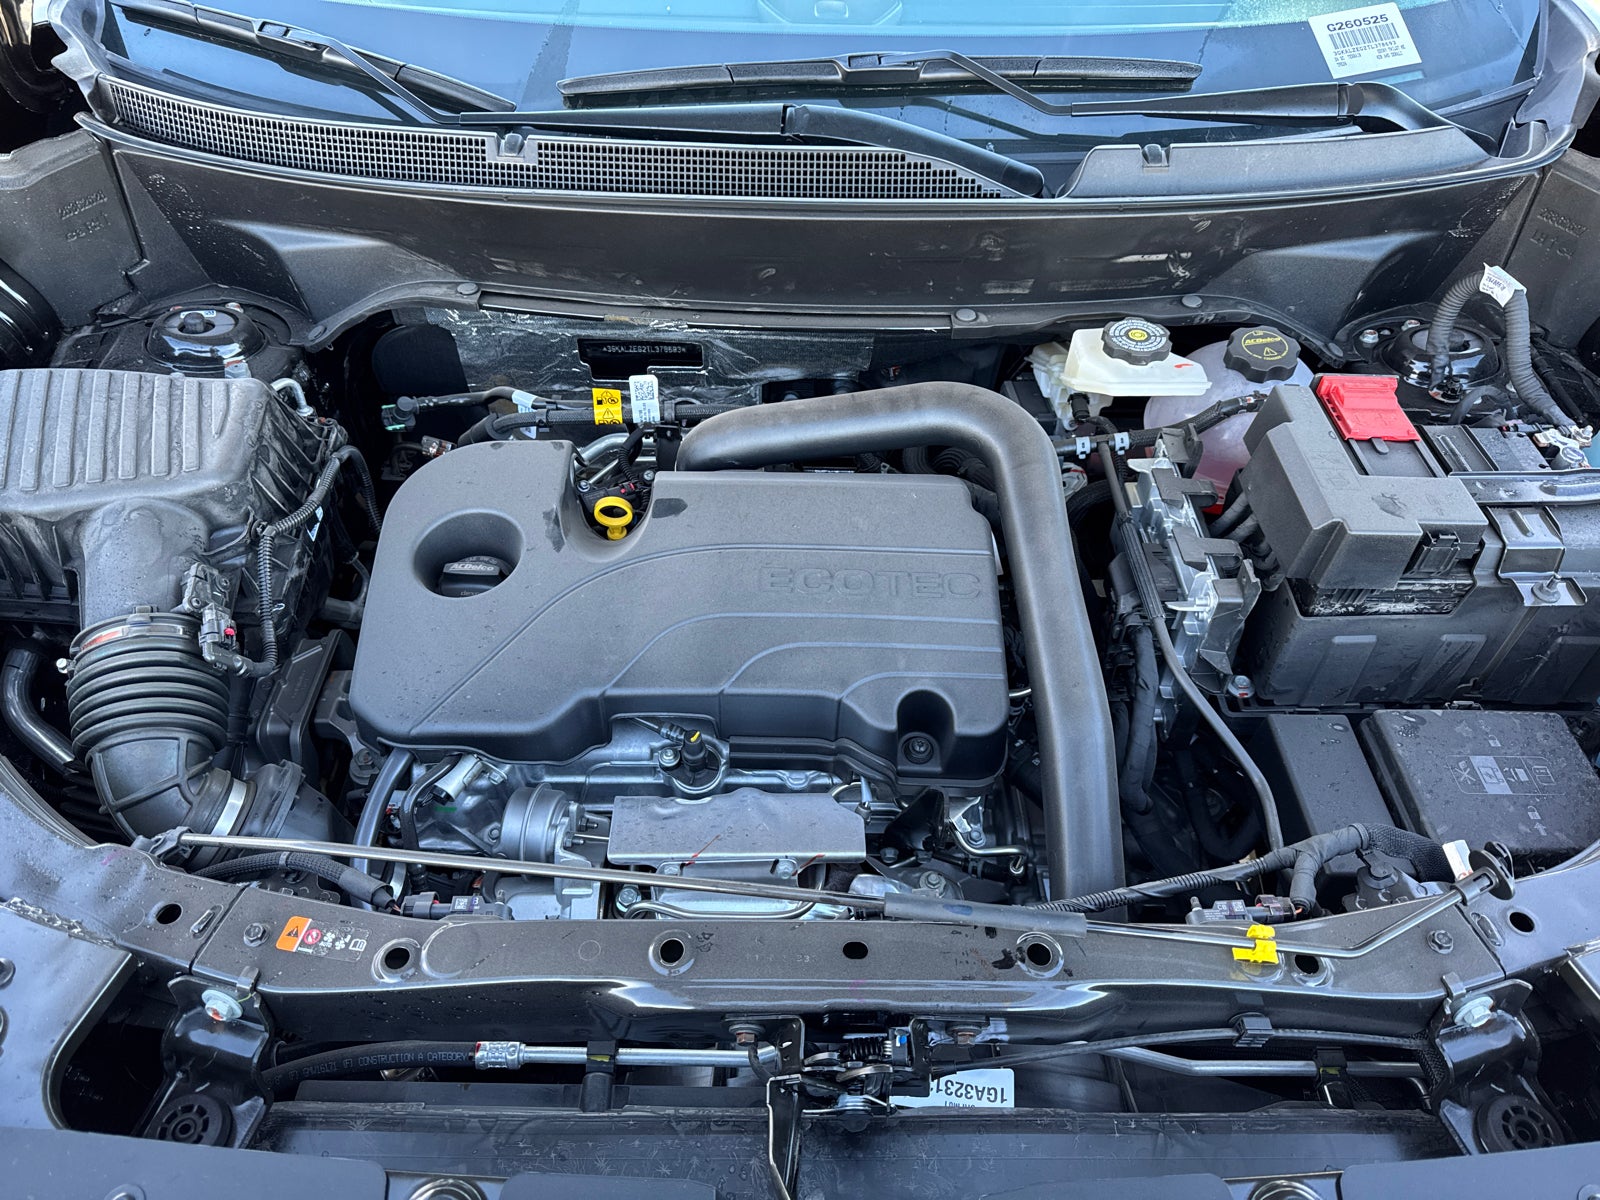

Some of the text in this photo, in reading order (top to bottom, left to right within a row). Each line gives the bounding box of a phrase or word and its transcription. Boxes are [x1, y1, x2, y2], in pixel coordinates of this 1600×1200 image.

[1327, 13, 1388, 32] G260525
[449, 563, 495, 571] ACDelco
[759, 566, 981, 598] ECOTEC
[358, 1053, 414, 1066] CONSTRUCTION
[418, 1053, 424, 1062] A
[427, 1052, 469, 1062] CATEGORY
[931, 1079, 1007, 1104] 1GA3231
